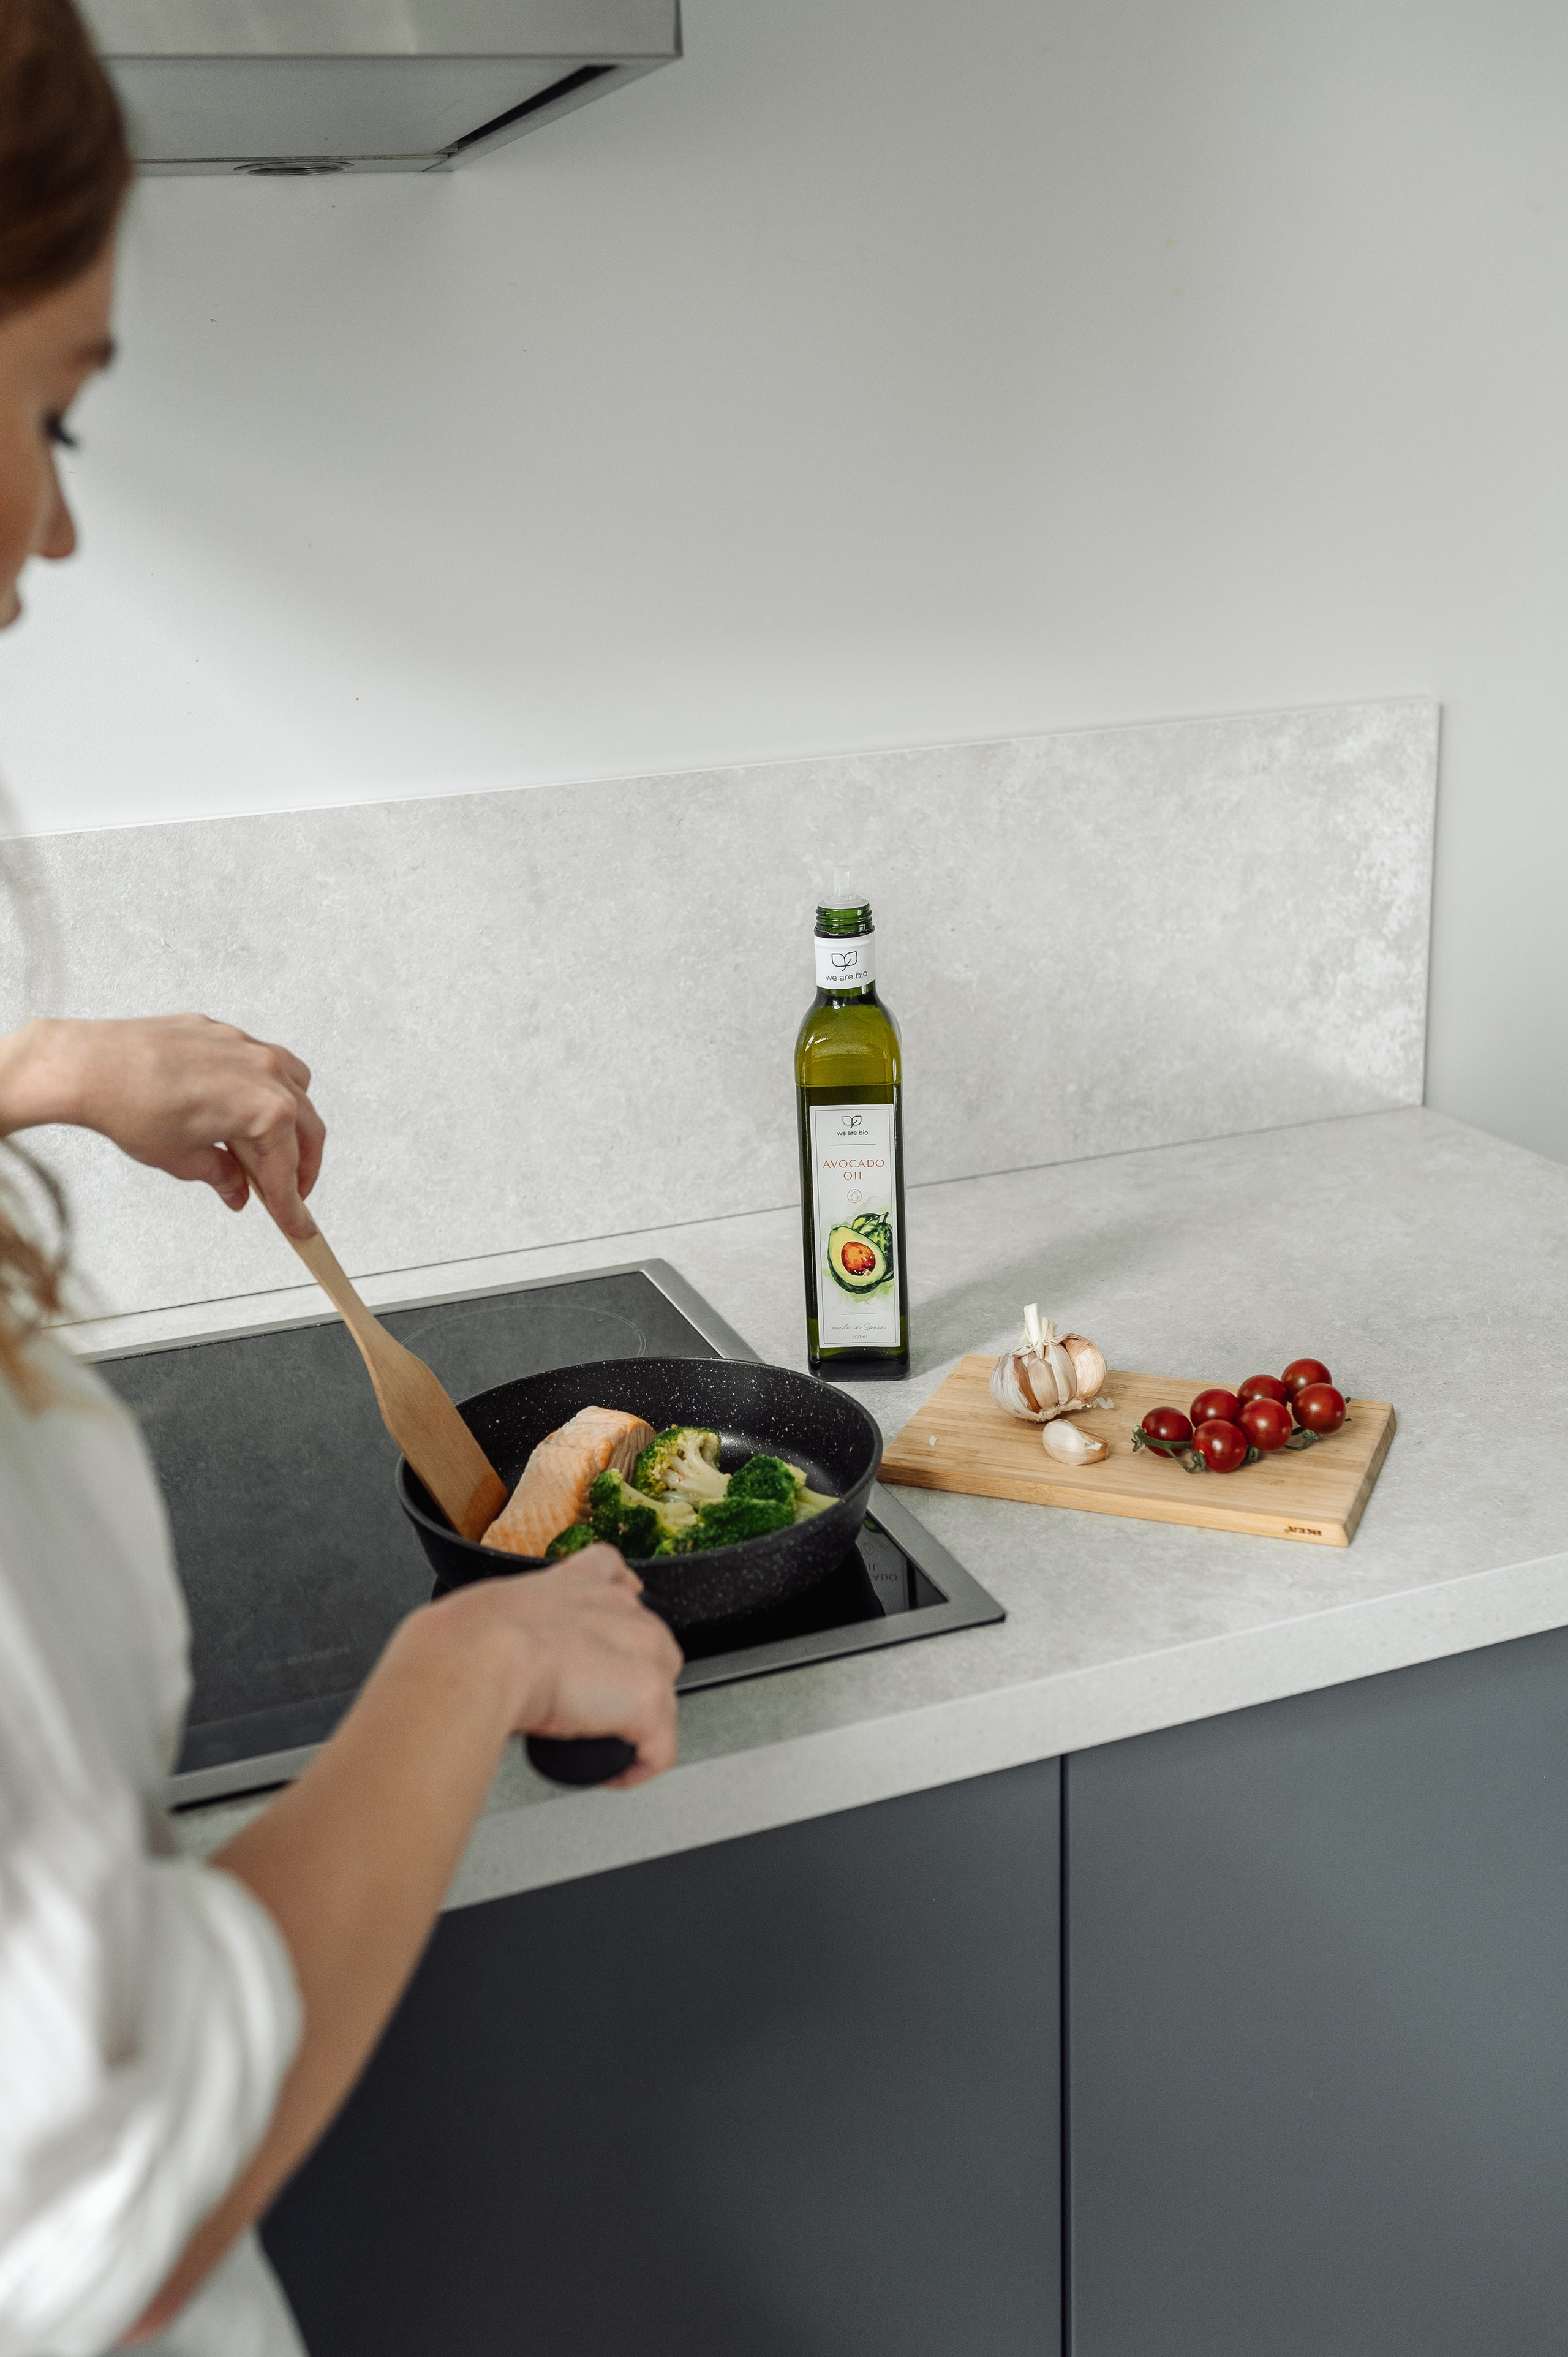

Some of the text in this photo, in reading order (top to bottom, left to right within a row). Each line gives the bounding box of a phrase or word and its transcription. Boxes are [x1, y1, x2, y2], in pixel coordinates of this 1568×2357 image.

[856, 970, 867, 979] bio
[823, 1159, 884, 1168] AVOCADO
[843, 1171, 865, 1180] OIL
[864, 1322, 887, 1331] Spain
